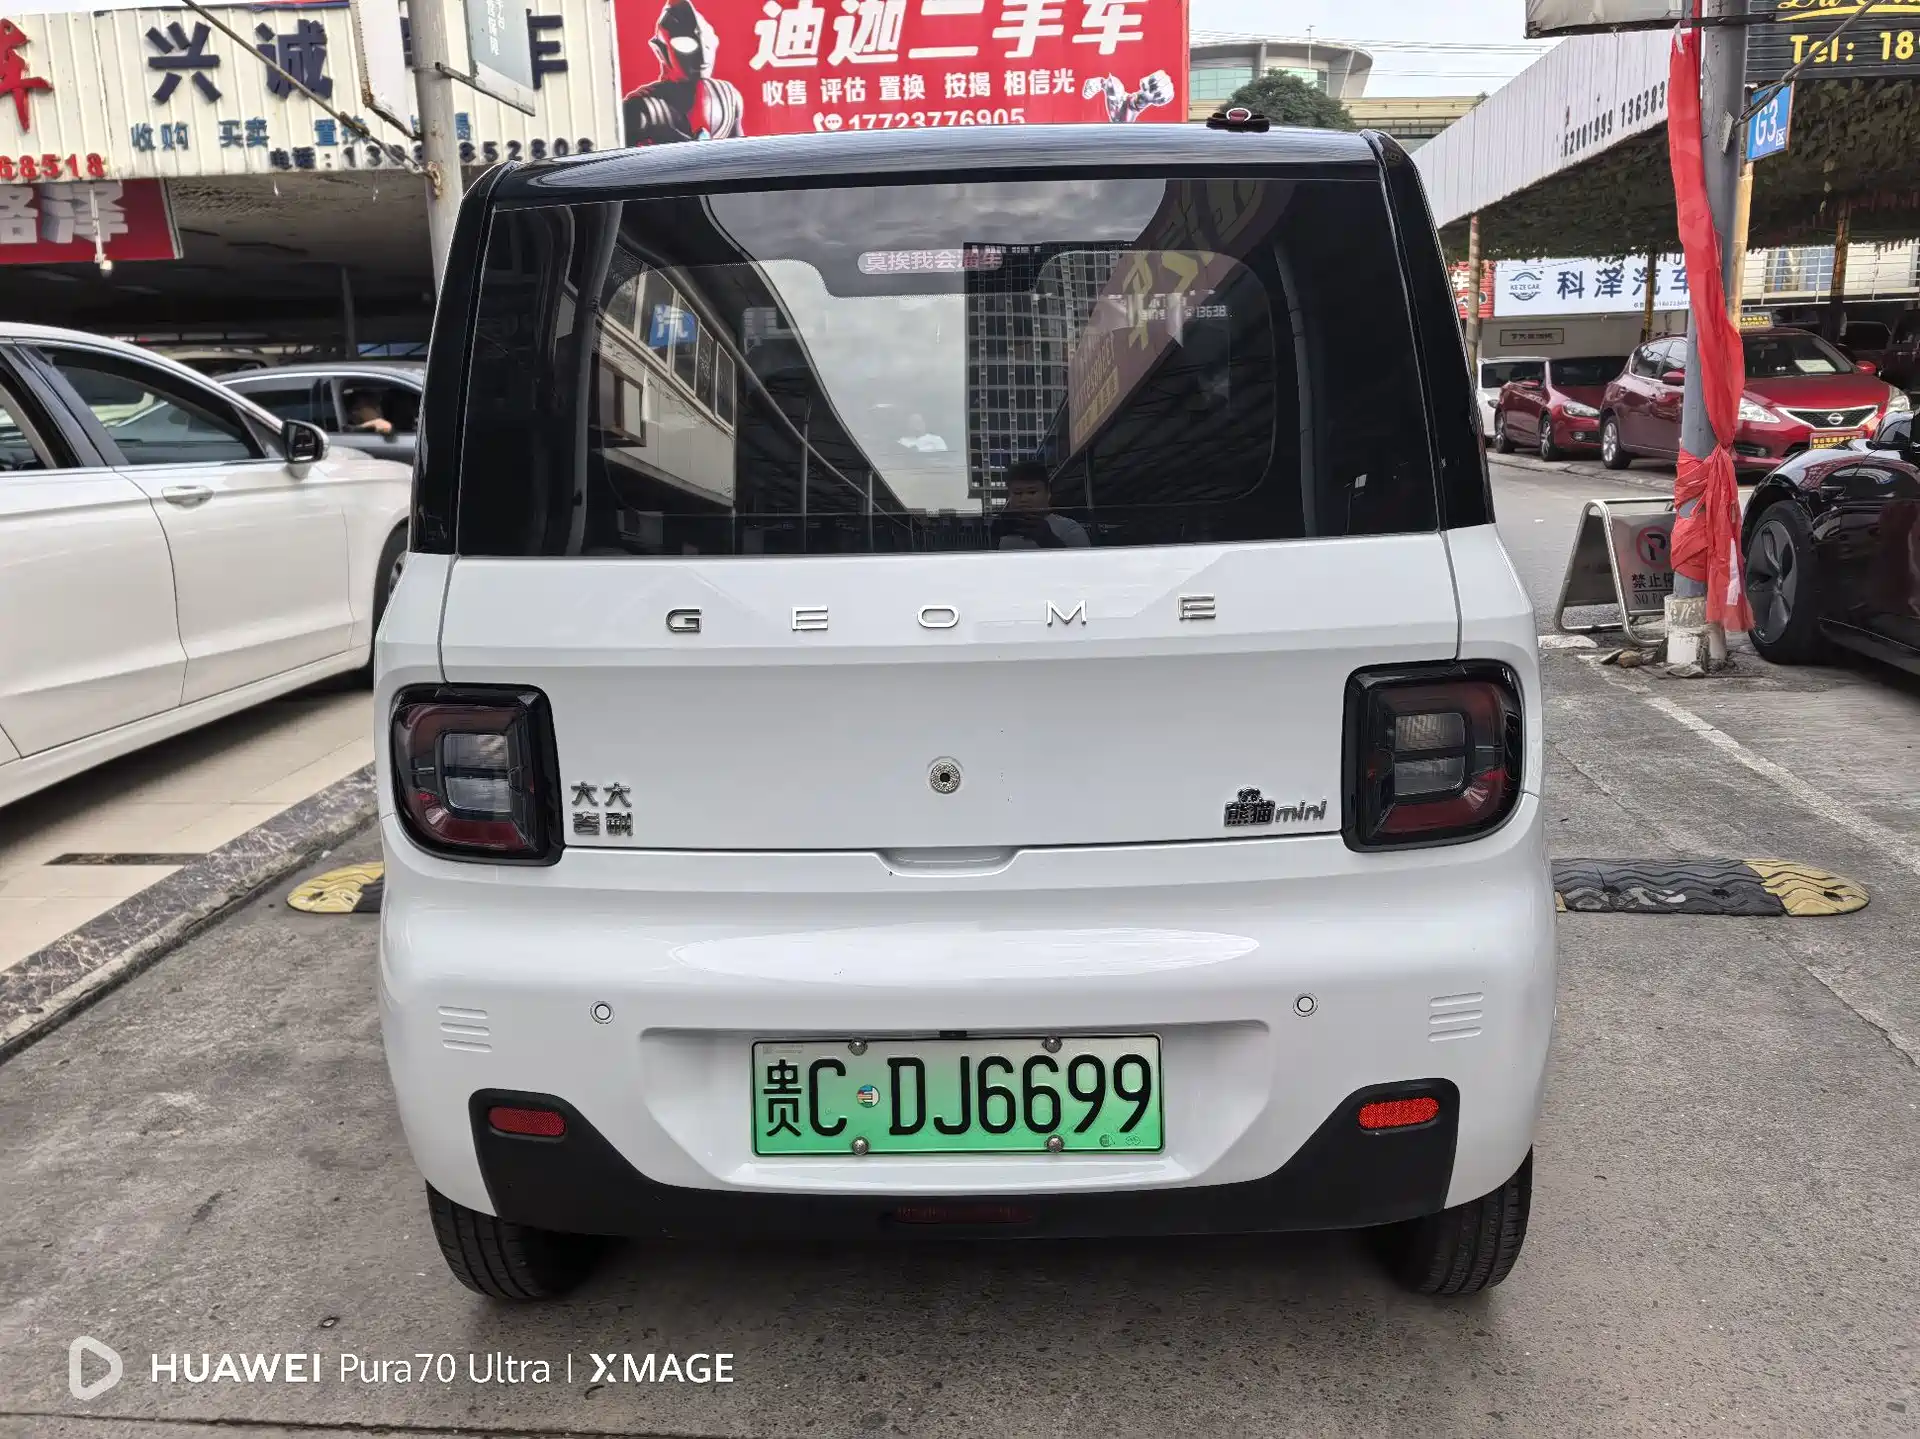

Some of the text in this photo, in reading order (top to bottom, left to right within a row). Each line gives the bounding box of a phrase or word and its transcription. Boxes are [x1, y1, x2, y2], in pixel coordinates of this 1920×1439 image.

[749, 0, 1144, 70] 迪迦二手车
[1879, 30, 1920, 61] 18
[762, 68, 1075, 106] 收售 评估 置换 按揭 相信光
[131, 121, 190, 152] 收购
[218, 116, 270, 149] 买卖
